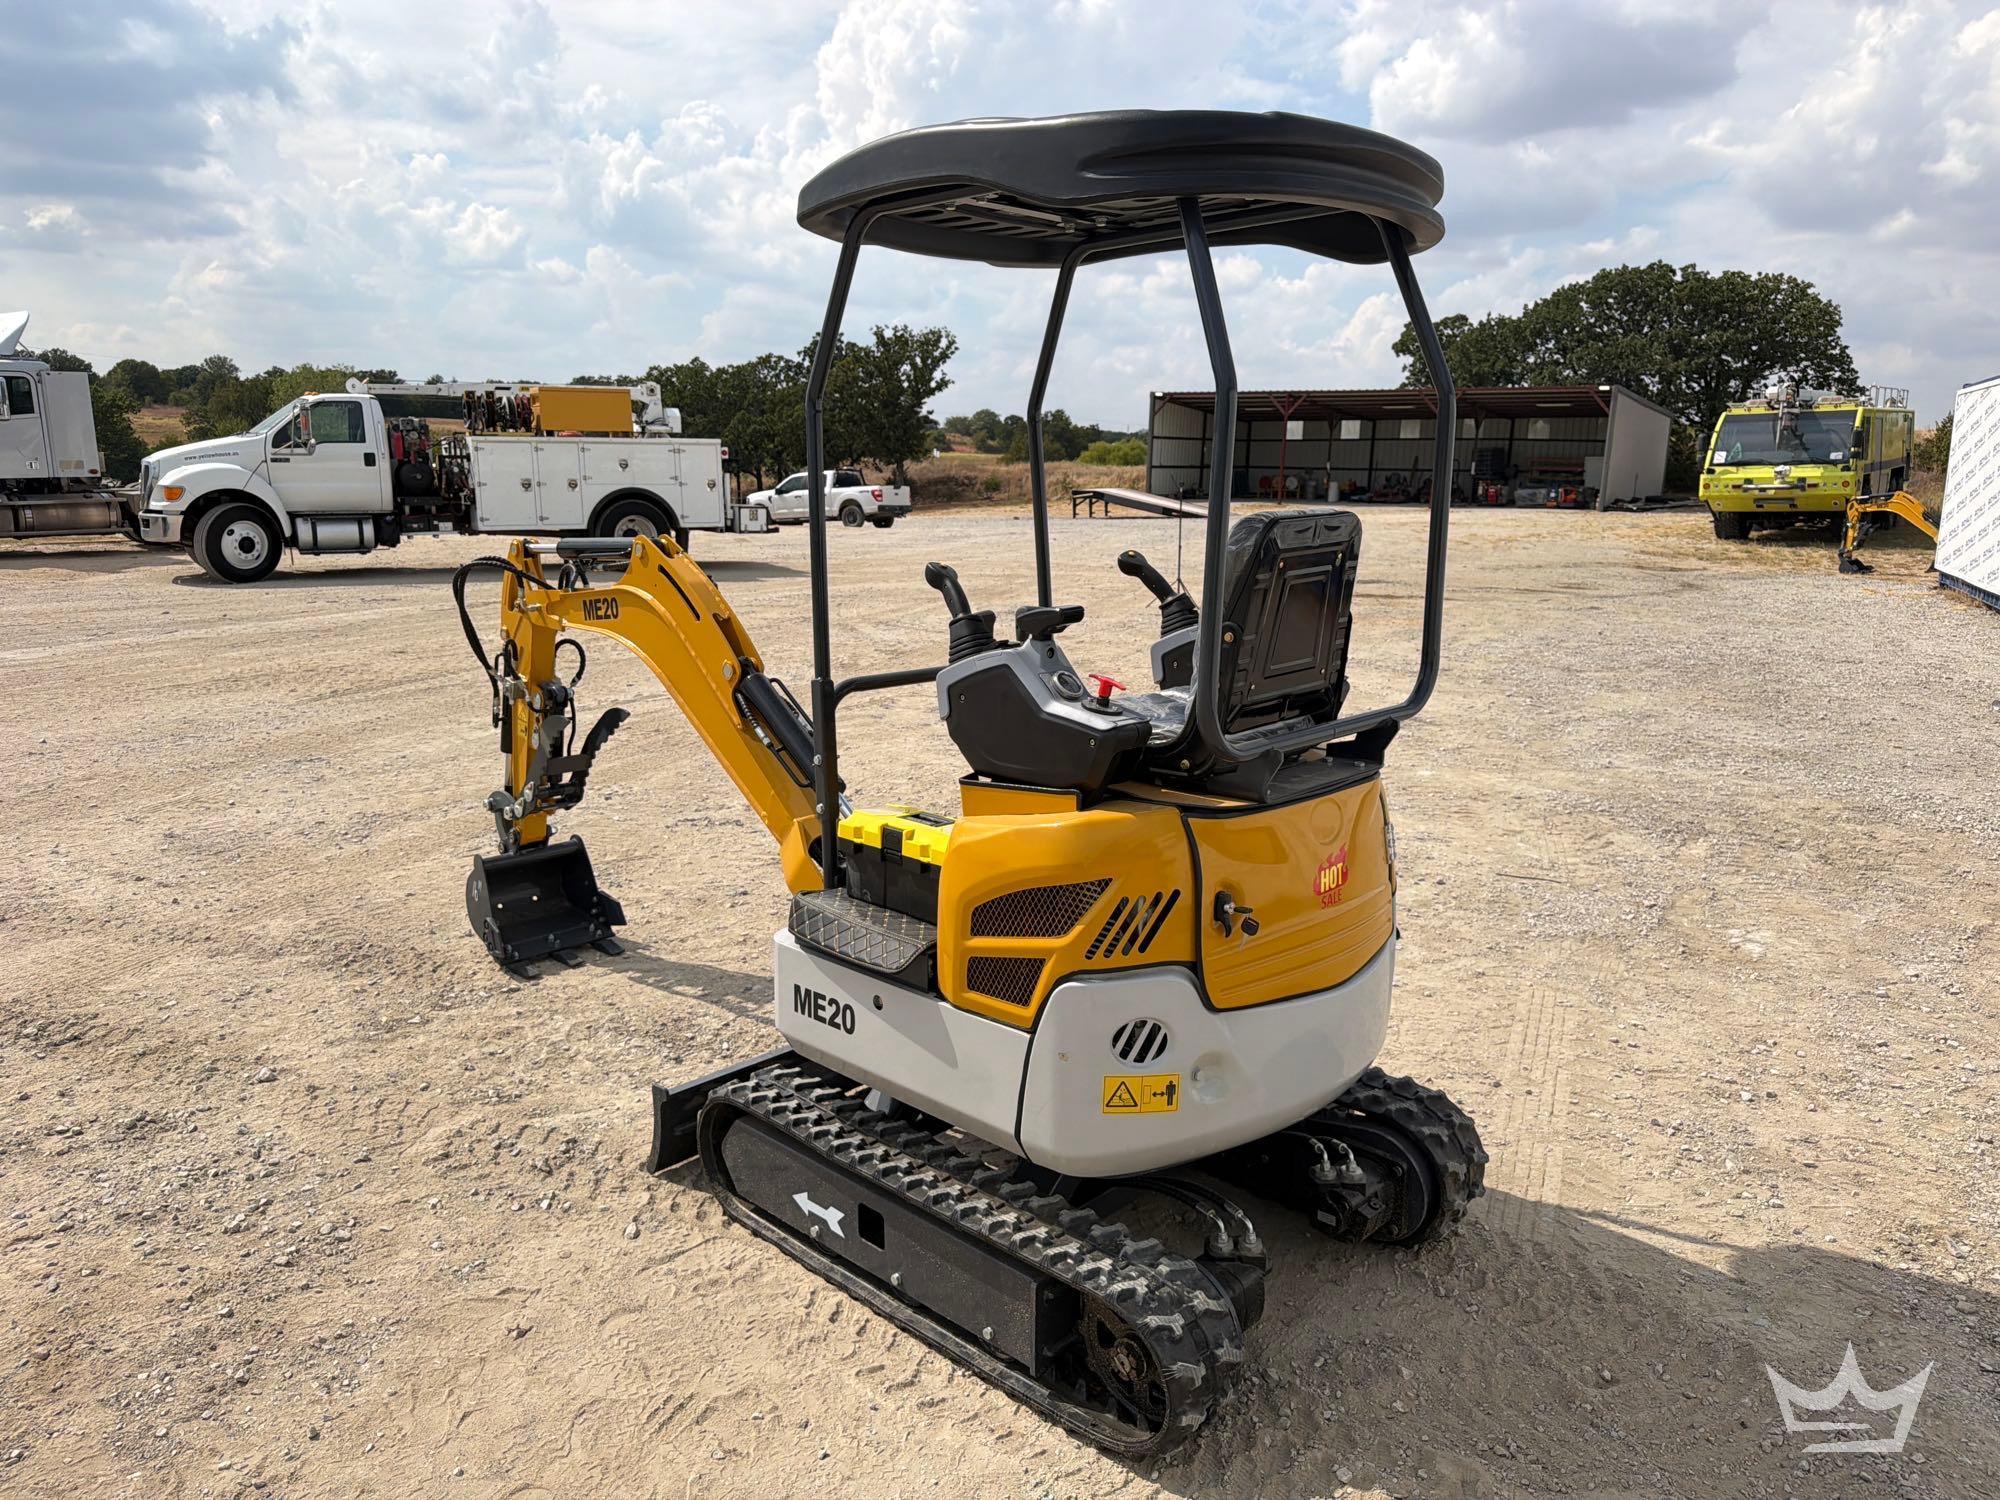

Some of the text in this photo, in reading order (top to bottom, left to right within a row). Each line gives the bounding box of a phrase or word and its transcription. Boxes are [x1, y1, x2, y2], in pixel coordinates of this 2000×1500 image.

[582, 596, 619, 621] ME20
[1320, 862, 1343, 893] HOT
[1320, 888, 1343, 910] SALE
[793, 983, 856, 1035] ME20
